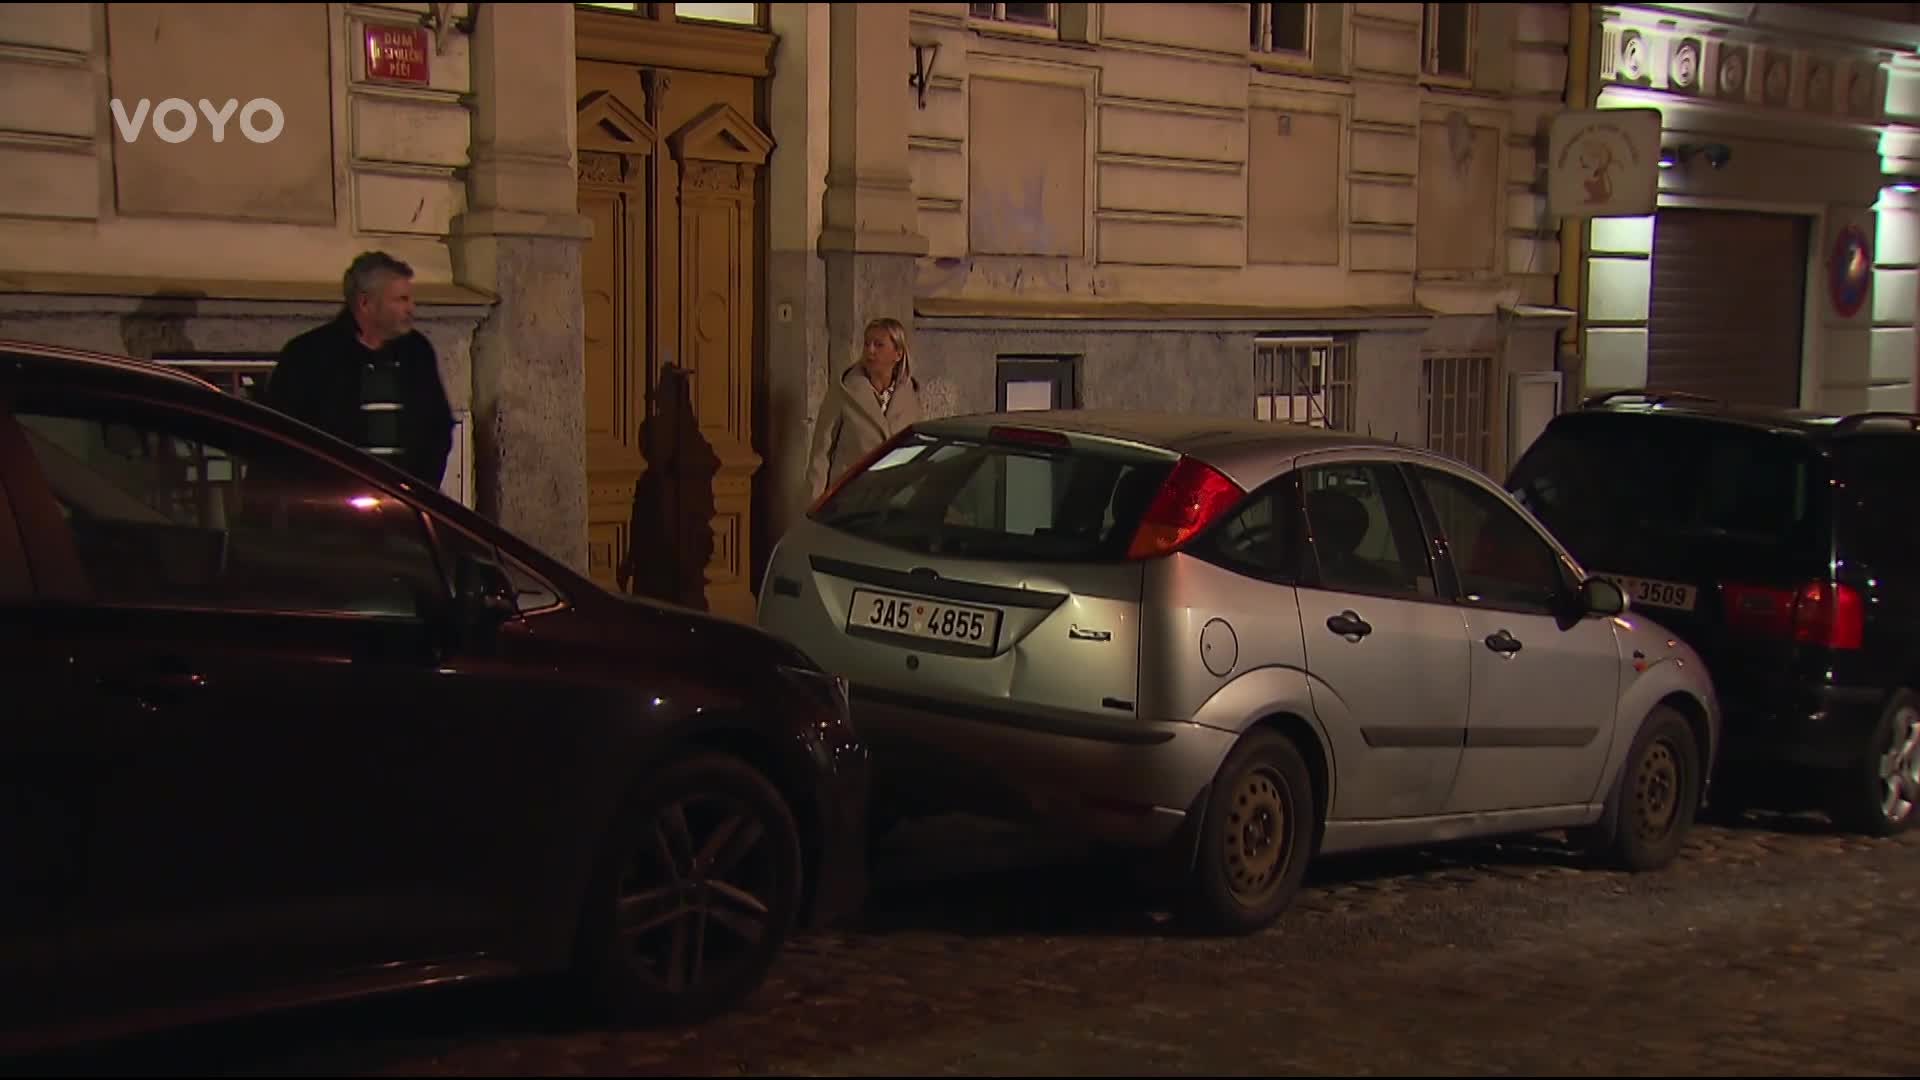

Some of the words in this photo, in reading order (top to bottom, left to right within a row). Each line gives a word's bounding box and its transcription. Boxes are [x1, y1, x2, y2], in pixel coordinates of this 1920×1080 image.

[1637, 582, 1686, 606] 3509
[870, 598, 912, 629] 3A5
[928, 607, 985, 640] 4855
